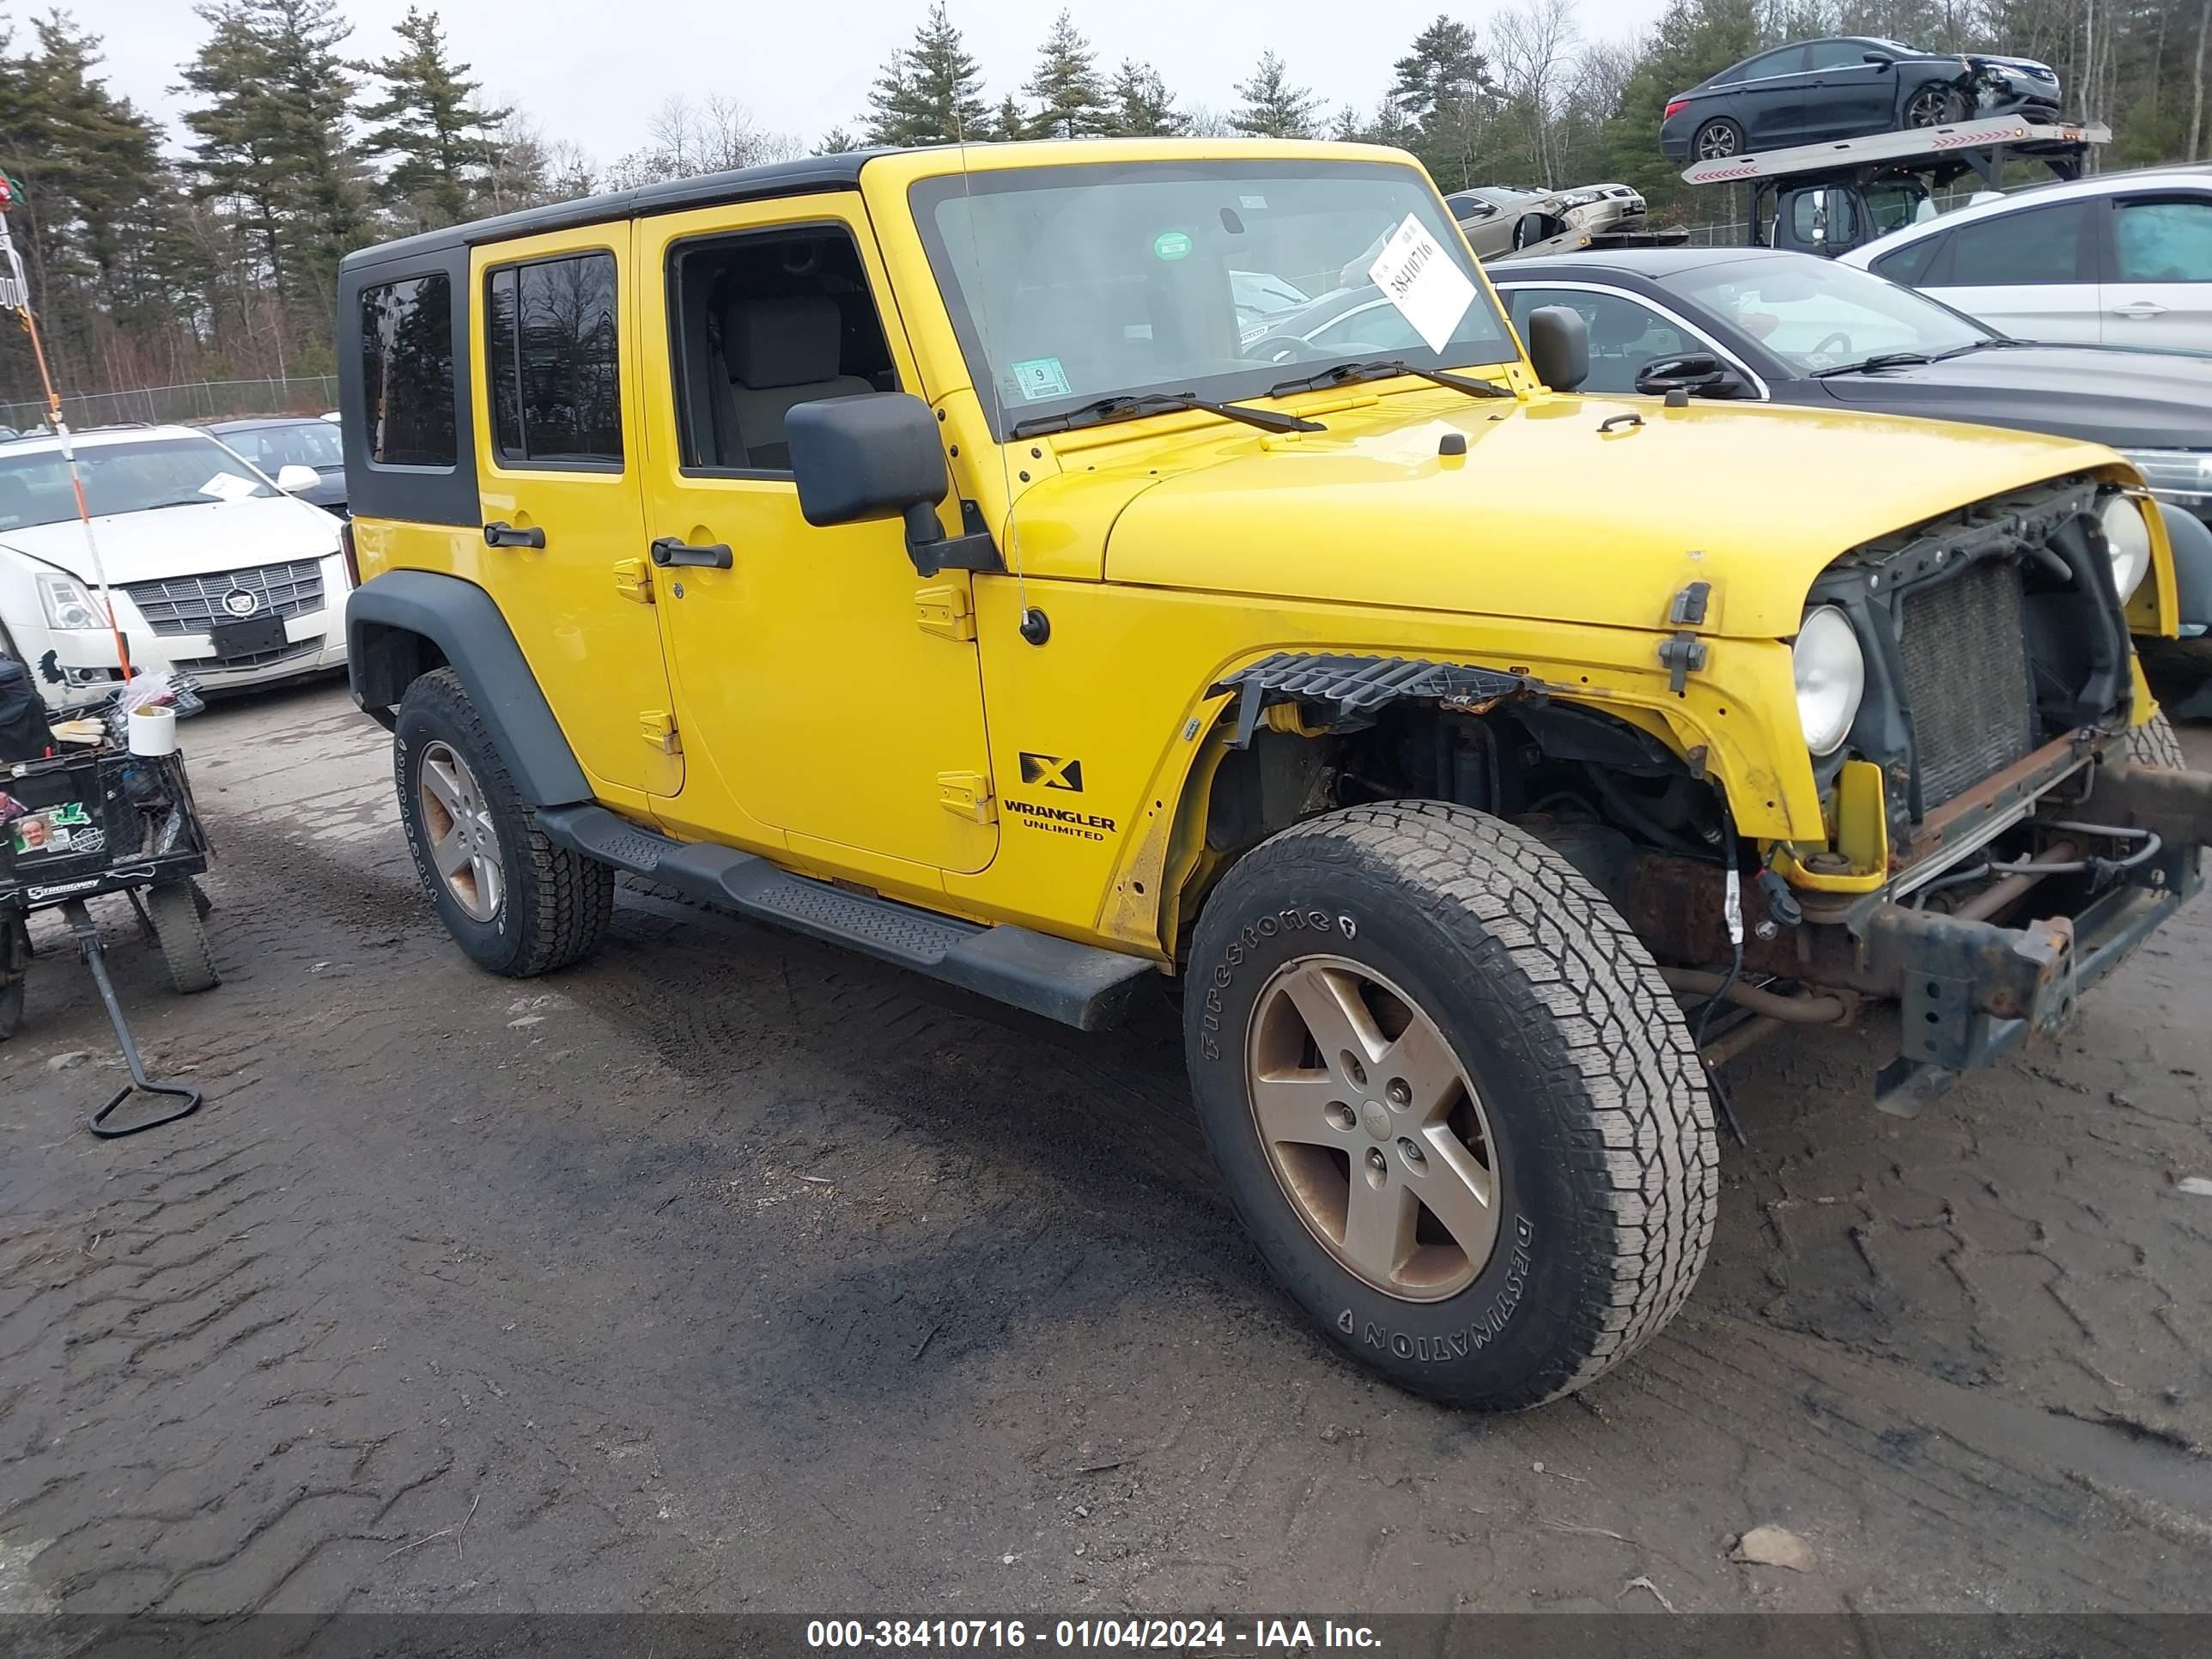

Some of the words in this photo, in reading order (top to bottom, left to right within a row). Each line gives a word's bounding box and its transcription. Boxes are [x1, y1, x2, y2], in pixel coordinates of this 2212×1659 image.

[1391, 240, 1434, 300] 38410716
[1035, 368, 1045, 381] 9
[1004, 799, 1118, 833] WRANGLER
[1024, 818, 1105, 842] UNLIMITED
[1201, 909, 1331, 1060] Firestone
[1364, 1213, 1535, 1361] DESTINATION
